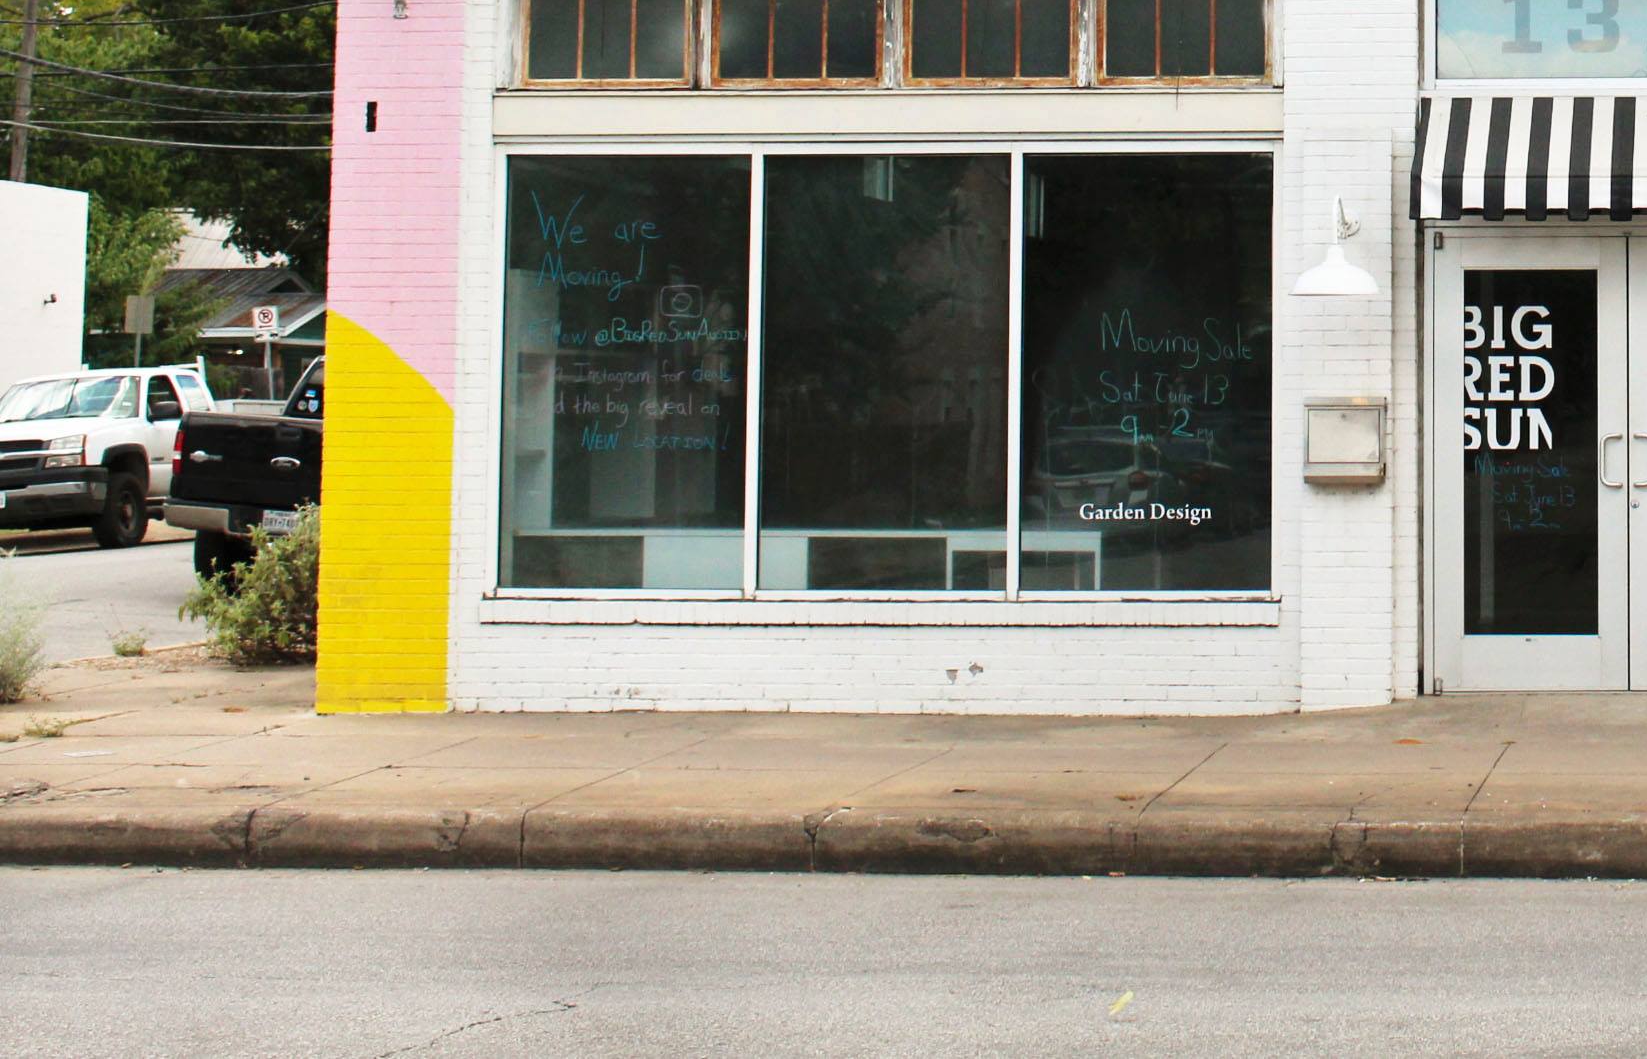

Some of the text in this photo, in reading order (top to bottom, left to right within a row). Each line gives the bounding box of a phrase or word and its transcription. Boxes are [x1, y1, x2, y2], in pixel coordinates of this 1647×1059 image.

[532, 190, 664, 248] We are
[1100, 307, 1254, 369] Moving Sale
[1464, 305, 1552, 350] BIG
[571, 361, 651, 391] Instagram
[661, 358, 685, 382] for
[1154, 372, 1194, 405] June
[1202, 373, 1230, 405] 13
[1464, 355, 1555, 401] RED
[574, 393, 600, 415] the
[606, 392, 631, 428] big
[639, 392, 693, 417] reveal
[581, 420, 621, 453] NEW
[1464, 407, 1552, 450] SUN
[1475, 450, 1534, 483] Moving
[1079, 502, 1213, 525] Garden Design
